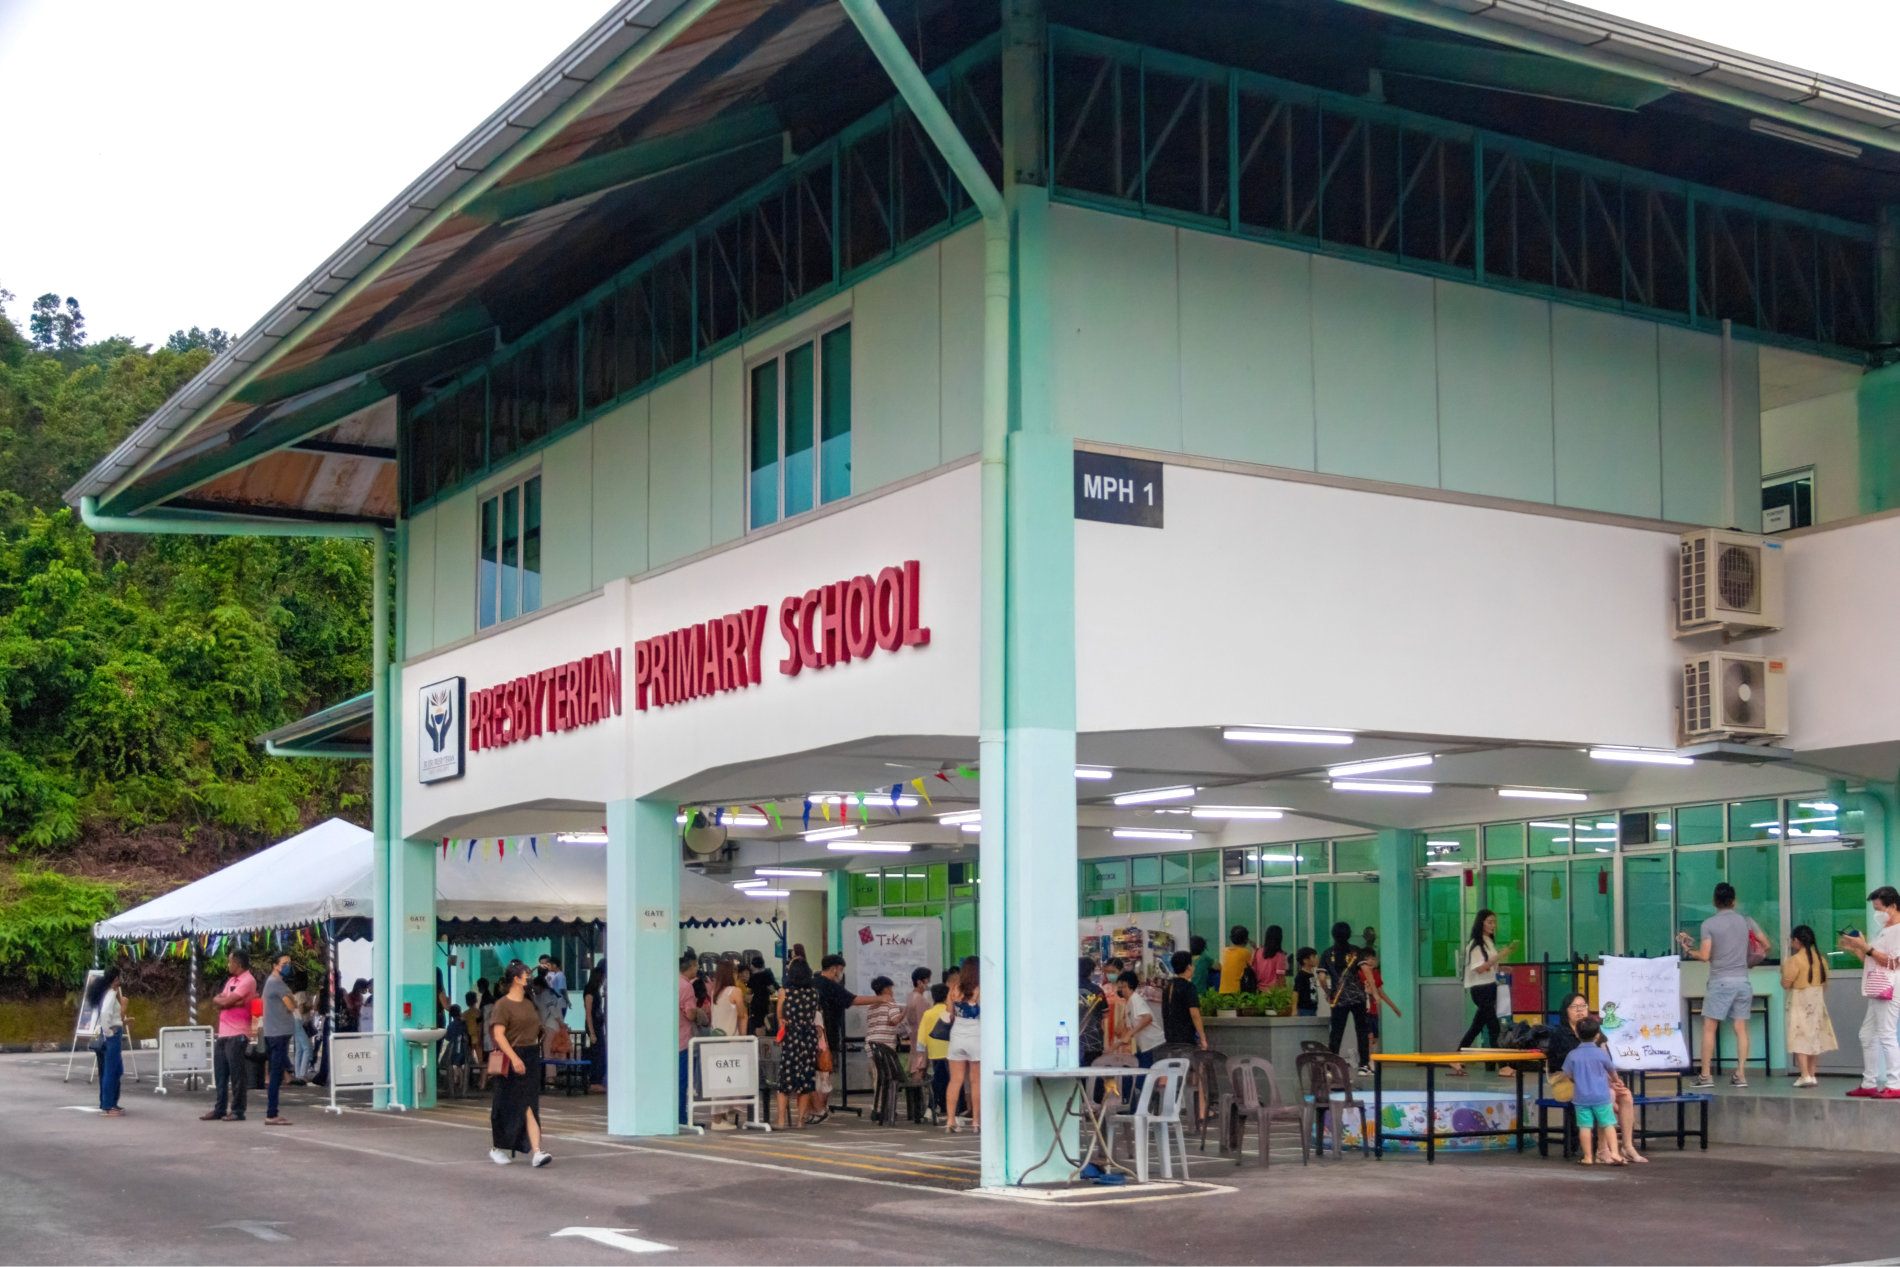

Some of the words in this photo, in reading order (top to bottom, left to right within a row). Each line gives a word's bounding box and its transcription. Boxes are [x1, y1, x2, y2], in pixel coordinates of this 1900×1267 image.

[1083, 473, 1133, 503] MPH
[1143, 482, 1153, 506] 1
[469, 647, 621, 751] PRESBYTERIAN
[635, 605, 768, 711] PRIMARY
[779, 560, 931, 676] SCHOOL
[347, 1051, 372, 1060] GATE
[1617, 1046, 1641, 1061] Lucky
[715, 1059, 741, 1068] GATE
[726, 1075, 732, 1084] 4
